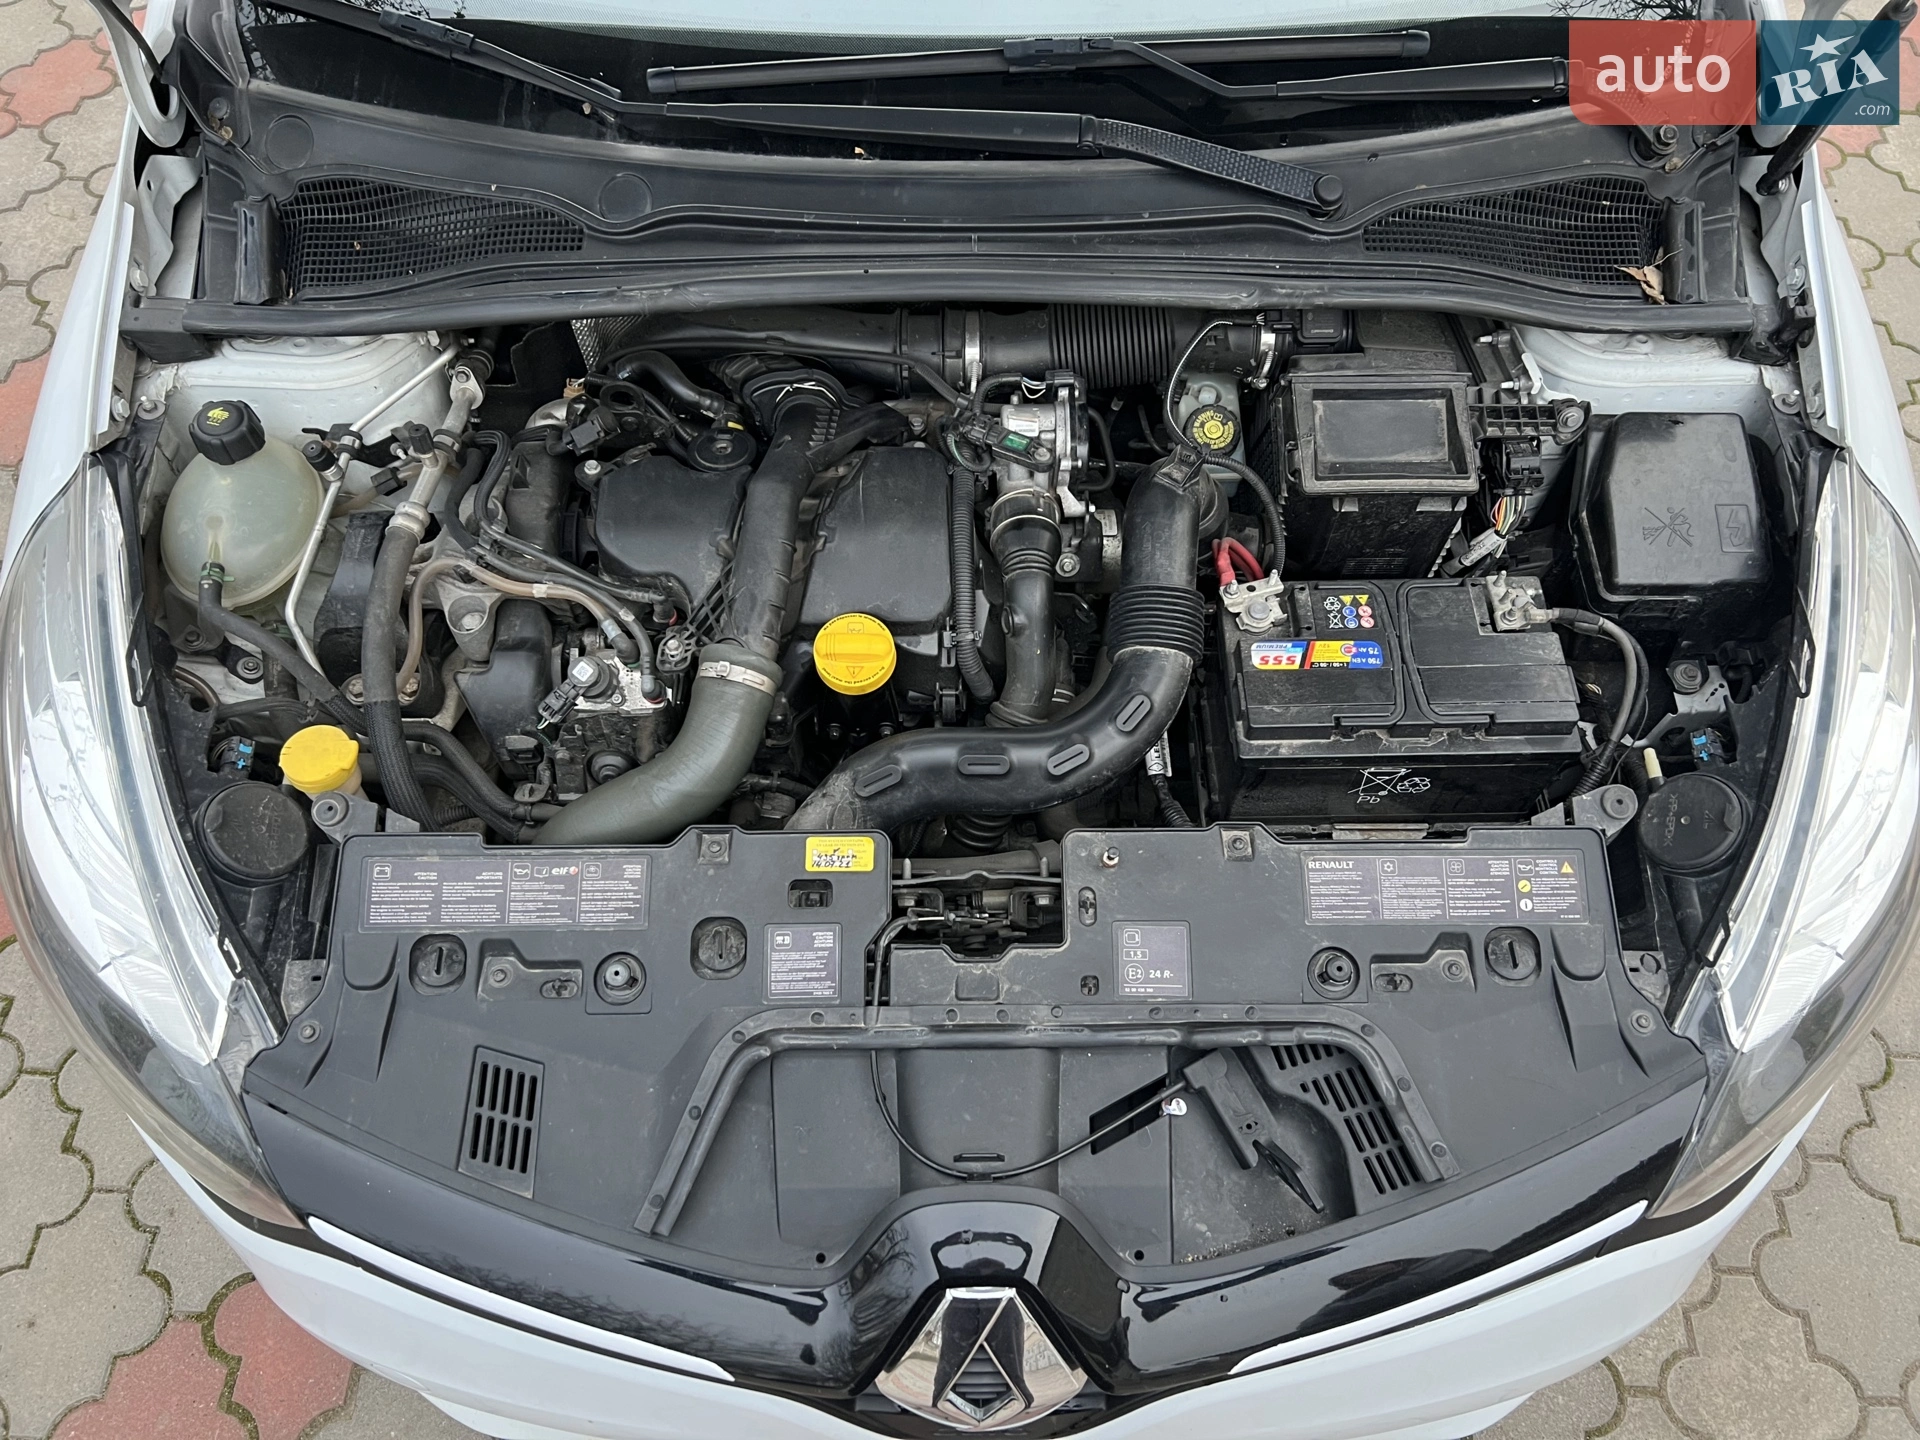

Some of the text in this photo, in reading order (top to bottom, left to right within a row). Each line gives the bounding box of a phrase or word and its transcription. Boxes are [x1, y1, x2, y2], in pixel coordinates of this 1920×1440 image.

[1259, 656, 1297, 665] 555
[551, 866, 569, 875] elf
[1130, 951, 1142, 959] 1,5
[1128, 968, 1174, 979] E2 24 R-
